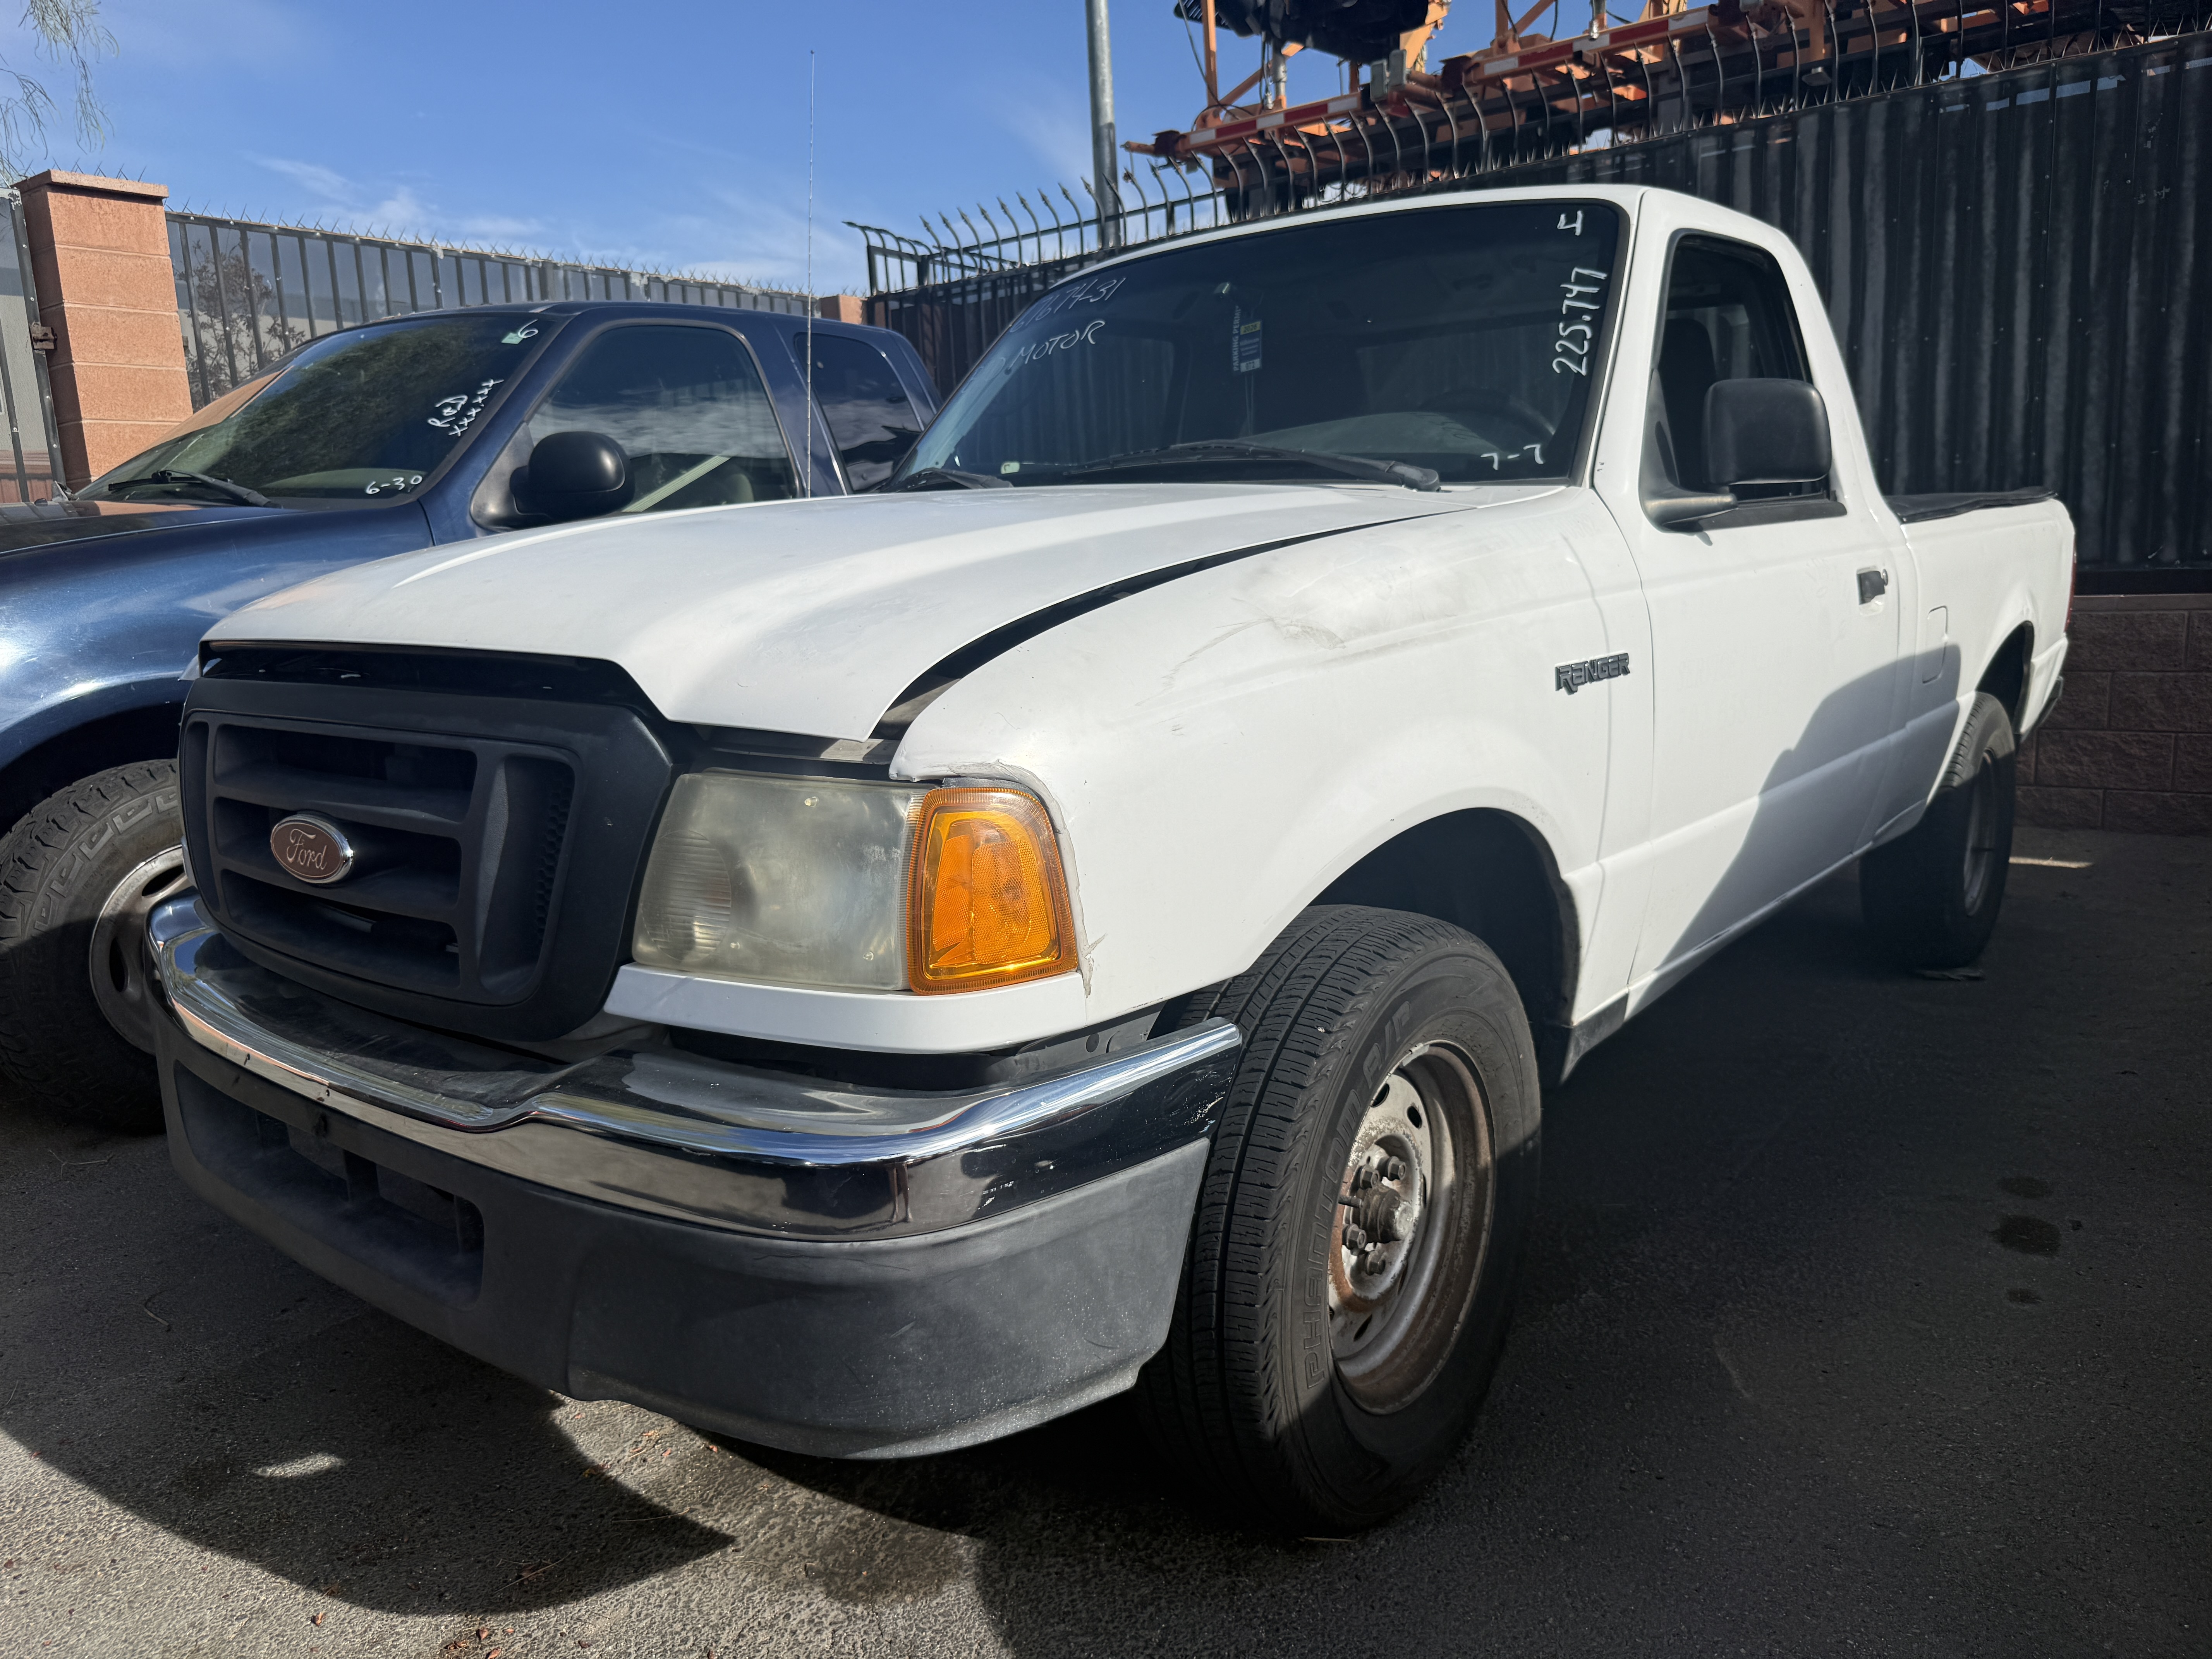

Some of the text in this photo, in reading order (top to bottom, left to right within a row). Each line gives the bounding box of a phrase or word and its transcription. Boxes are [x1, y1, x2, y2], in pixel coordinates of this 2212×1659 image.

[1557, 210, 1583, 236] 4
[518, 319, 539, 338] 6
[1008, 319, 1106, 370] MOTOR
[365, 474, 423, 494] 6-30
[1554, 653, 1631, 696] RANGER
[287, 828, 328, 870] Ford
